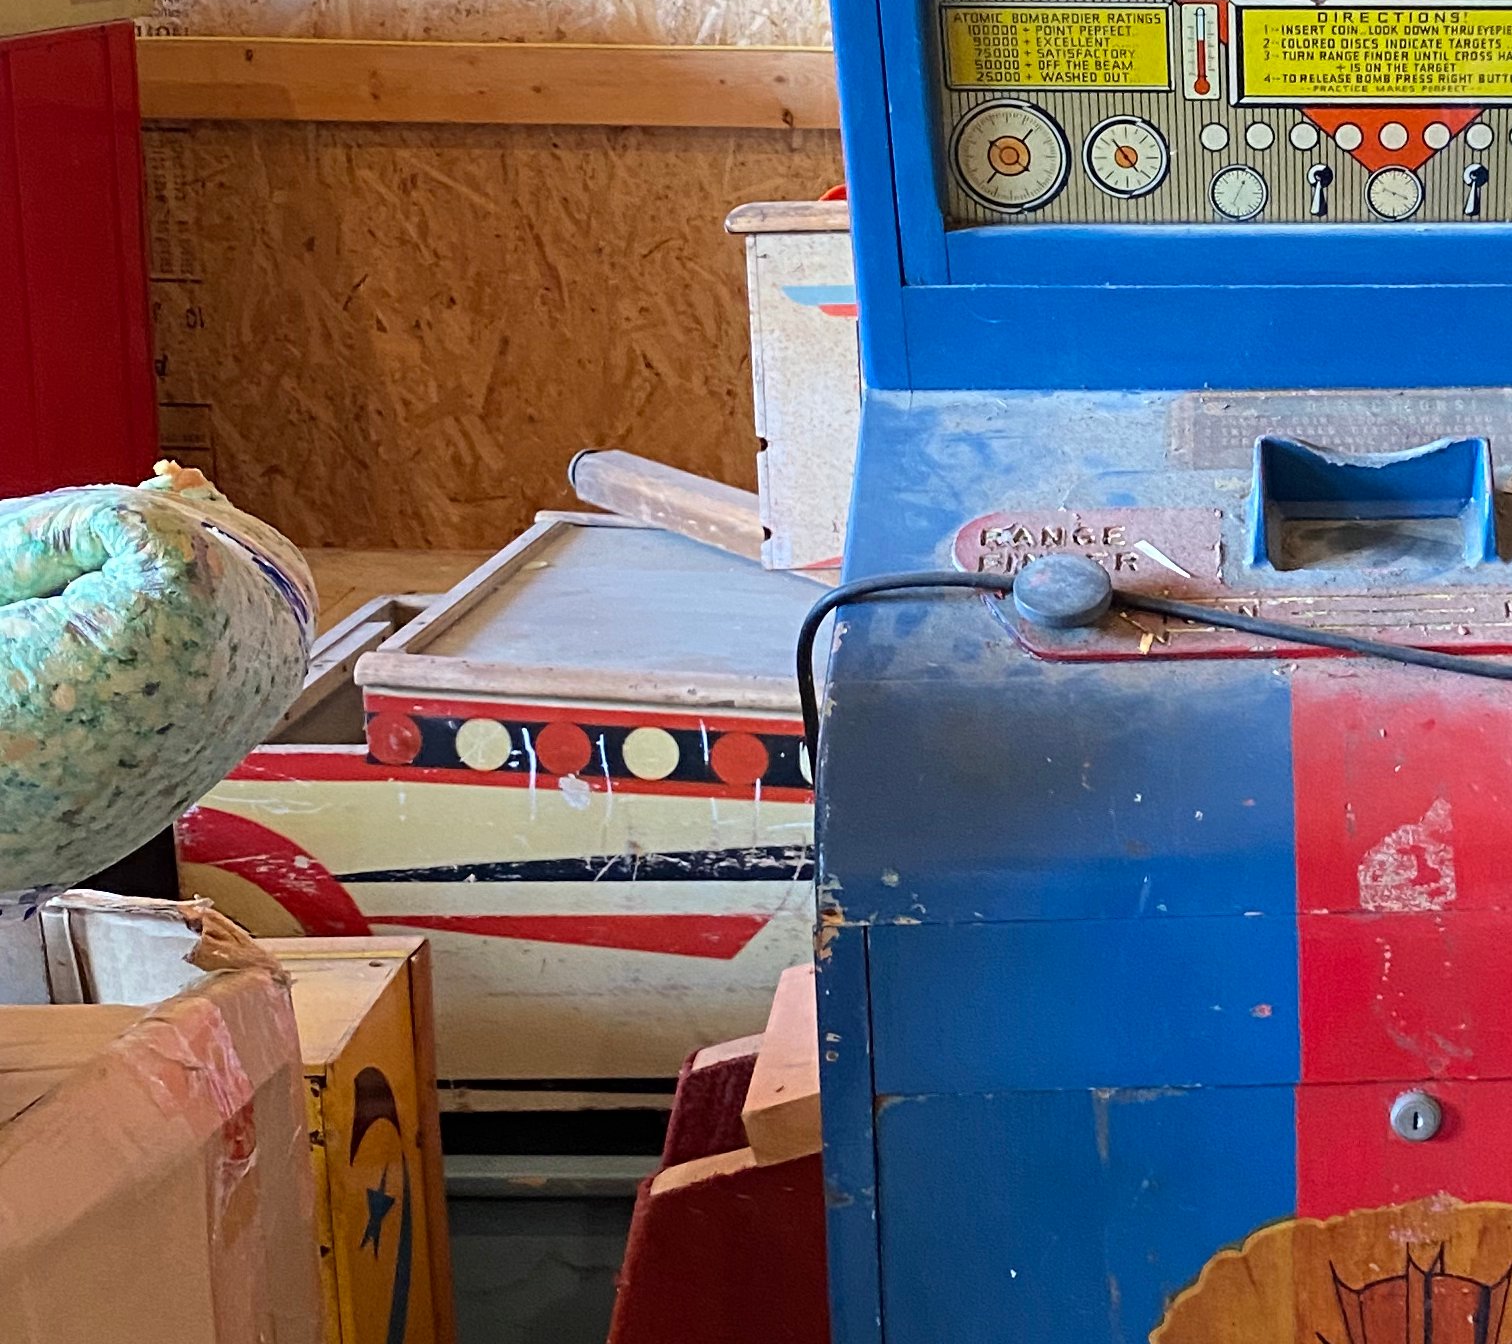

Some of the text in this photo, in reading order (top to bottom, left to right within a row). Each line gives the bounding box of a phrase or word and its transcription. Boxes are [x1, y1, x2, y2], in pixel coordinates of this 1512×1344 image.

[953, 12, 1162, 25] ATOMIC BOMBARDIER RATINGS
[1316, 11, 1470, 25] DIRECTIONS!
[1035, 24, 1073, 36] POINT
[1079, 24, 1132, 36] PERFECT
[1369, 25, 1399, 36] LOOK
[1403, 25, 1440, 36] DOWN
[1443, 25, 1474, 36] THRU
[1036, 37, 1111, 48] EXCELLENT
[1341, 38, 1379, 49] DISCS
[1384, 38, 1443, 49] INDICATE
[1447, 38, 1502, 49] TARGETS
[1036, 49, 1136, 60] SATISFACTORY
[1319, 51, 1358, 62] RANGE
[1363, 51, 1409, 62] FINDER
[1415, 50, 1450, 61] UNTIL
[1454, 50, 1494, 62] CROSS
[1038, 60, 1061, 71] OFF
[1066, 60, 1090, 71] THE
[1093, 60, 1134, 71] BEAM
[1349, 62, 1457, 73] IS ON THE TARGET
[1041, 72, 1099, 83] WASHED
[1103, 72, 1129, 83] OUT
[1299, 73, 1352, 84] RELEASE
[1355, 73, 1391, 84] BOMB
[1395, 73, 1435, 84] PRESS
[1439, 73, 1474, 84] RIGHT
[979, 524, 1127, 548] RANGE
